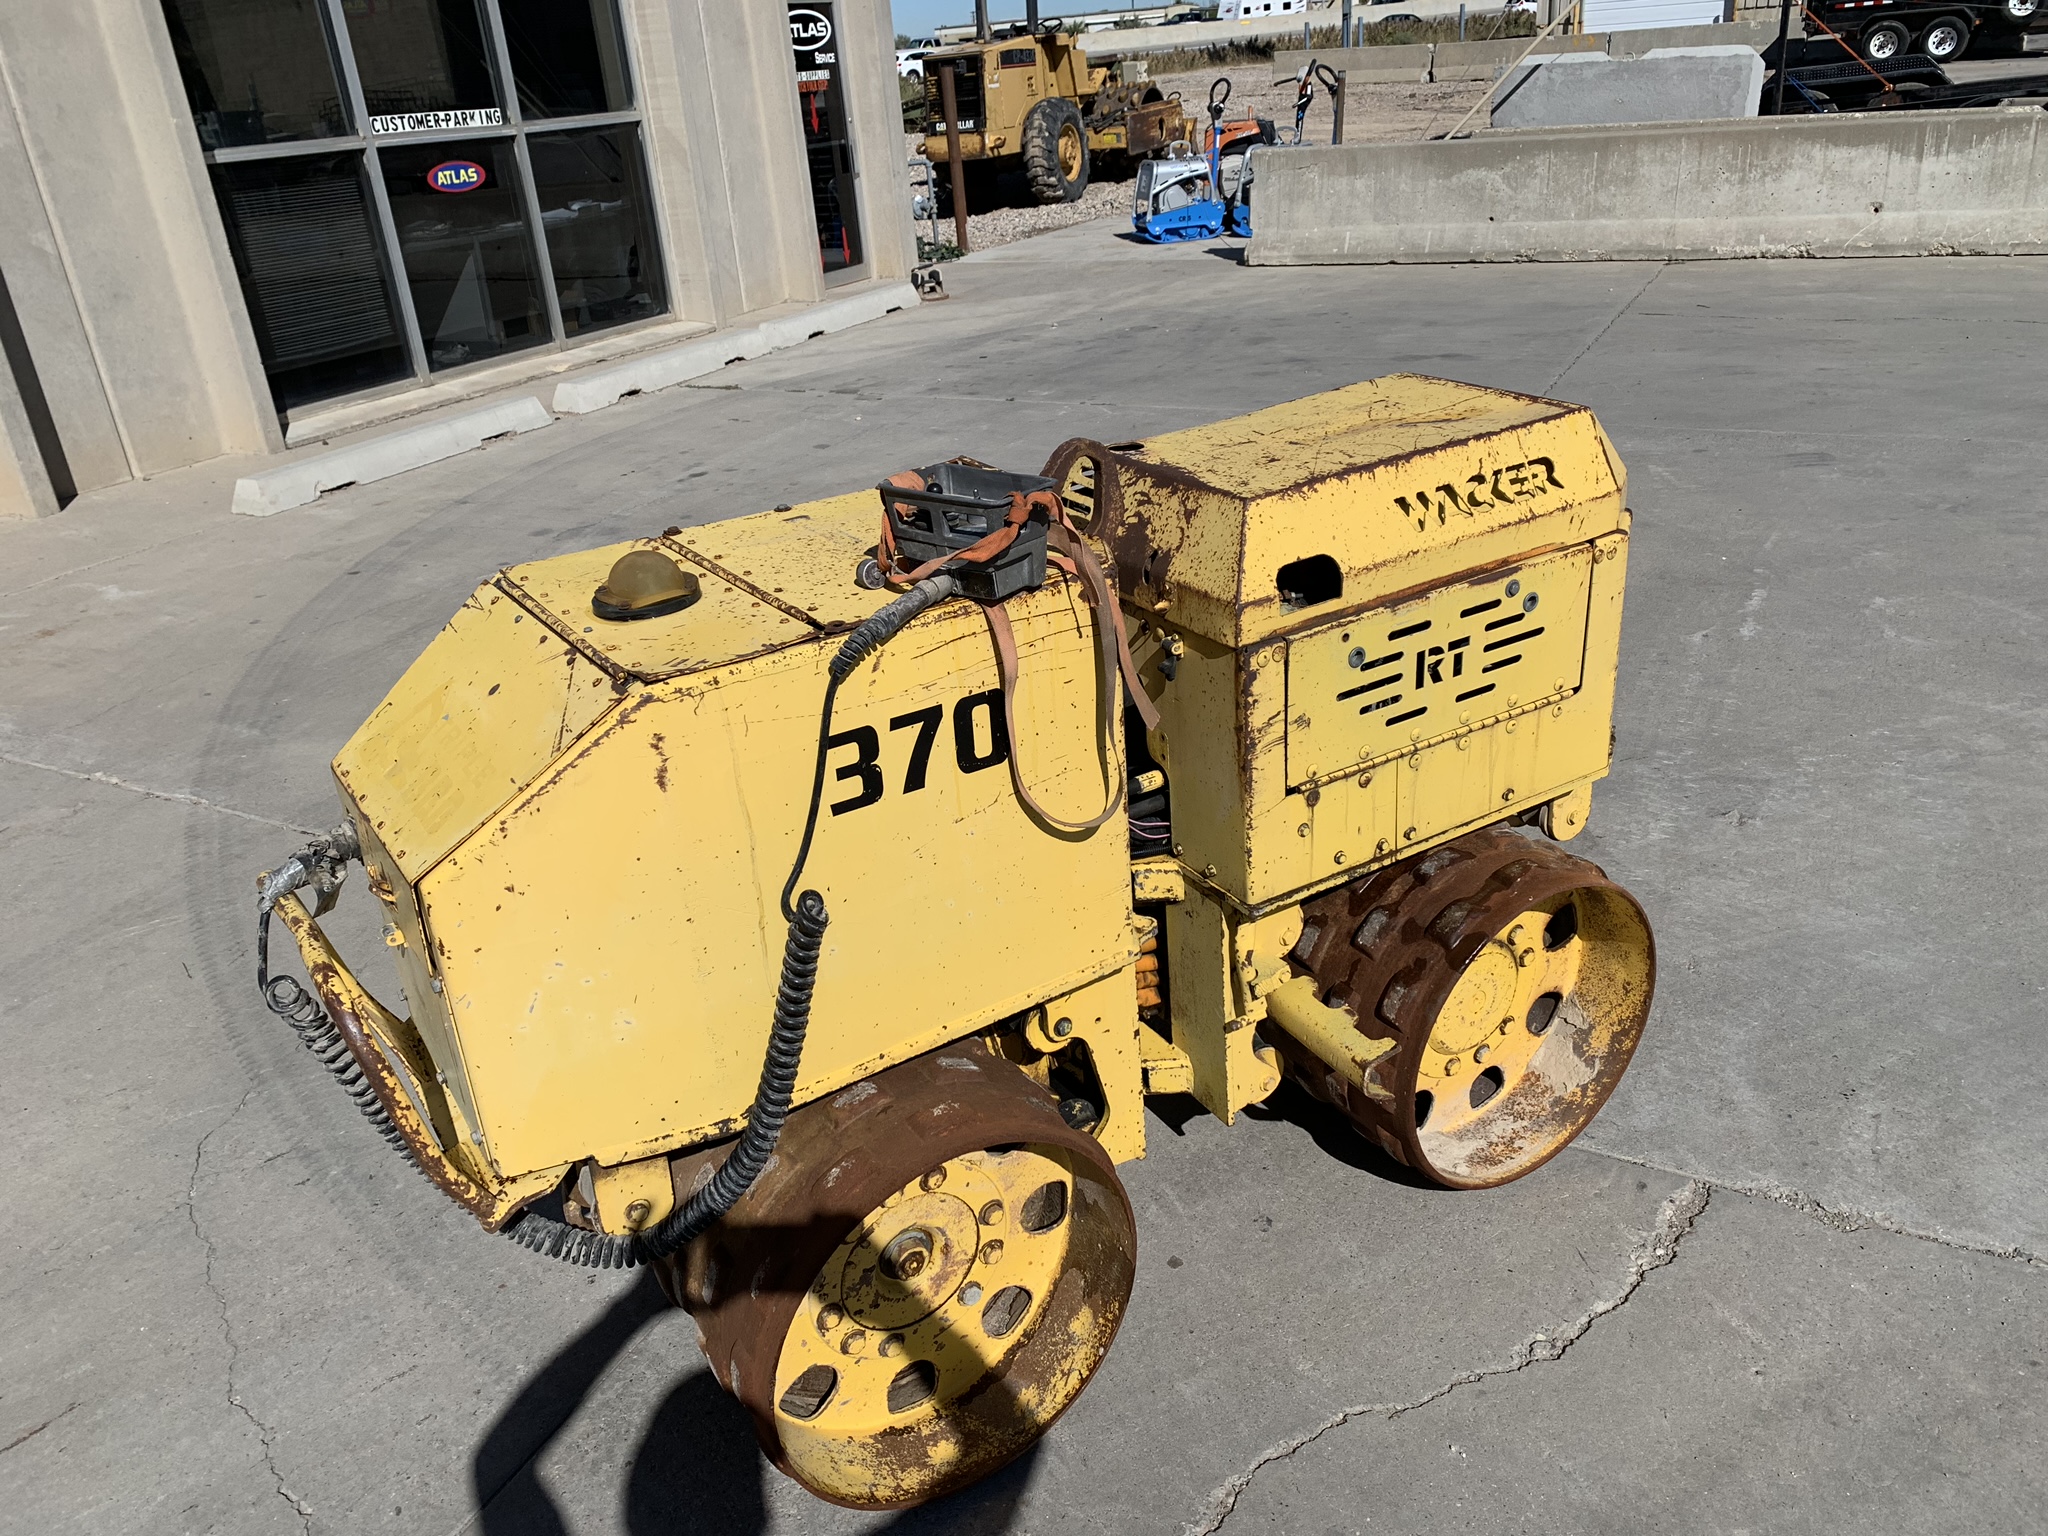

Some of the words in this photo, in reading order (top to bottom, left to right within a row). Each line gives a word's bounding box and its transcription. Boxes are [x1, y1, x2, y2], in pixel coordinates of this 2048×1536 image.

[790, 22, 826, 37] TLAS
[438, 168, 478, 185] ATLAS
[1393, 456, 1564, 533] WACKER
[1415, 635, 1471, 690] RT
[827, 688, 1009, 817] 370
